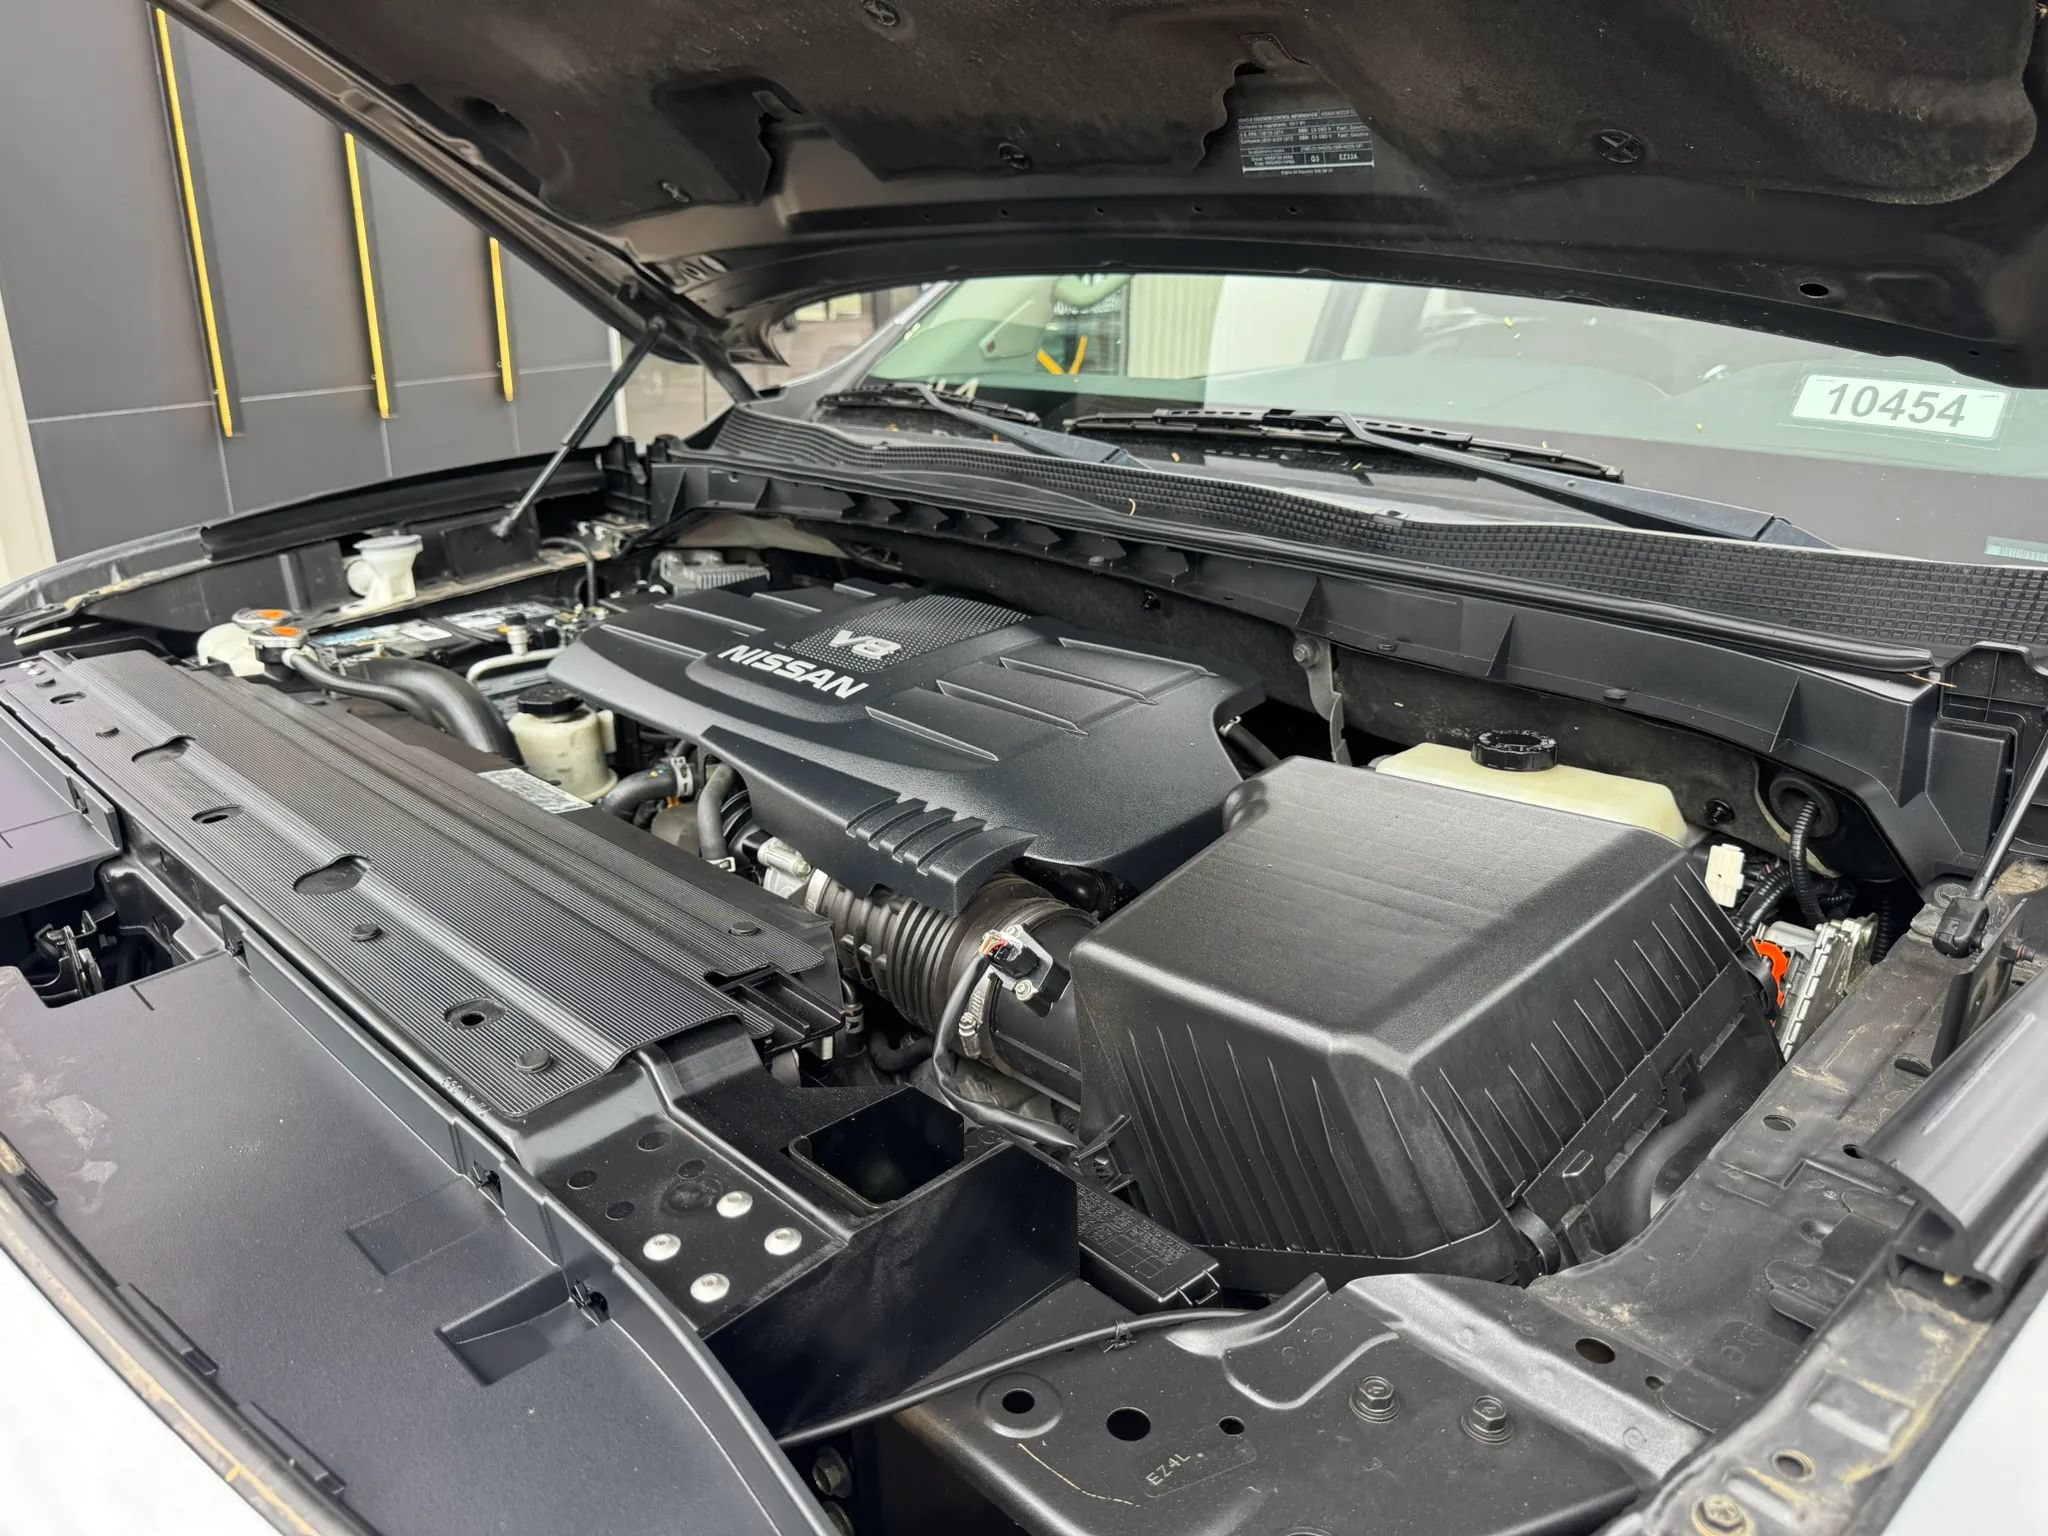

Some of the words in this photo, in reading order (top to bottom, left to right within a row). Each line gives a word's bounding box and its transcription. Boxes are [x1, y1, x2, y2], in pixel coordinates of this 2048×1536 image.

[1828, 383, 1968, 427] 10454
[829, 629, 902, 660] V8
[717, 644, 869, 699] NISSAN
[1145, 1453, 1191, 1486] EZ4L
